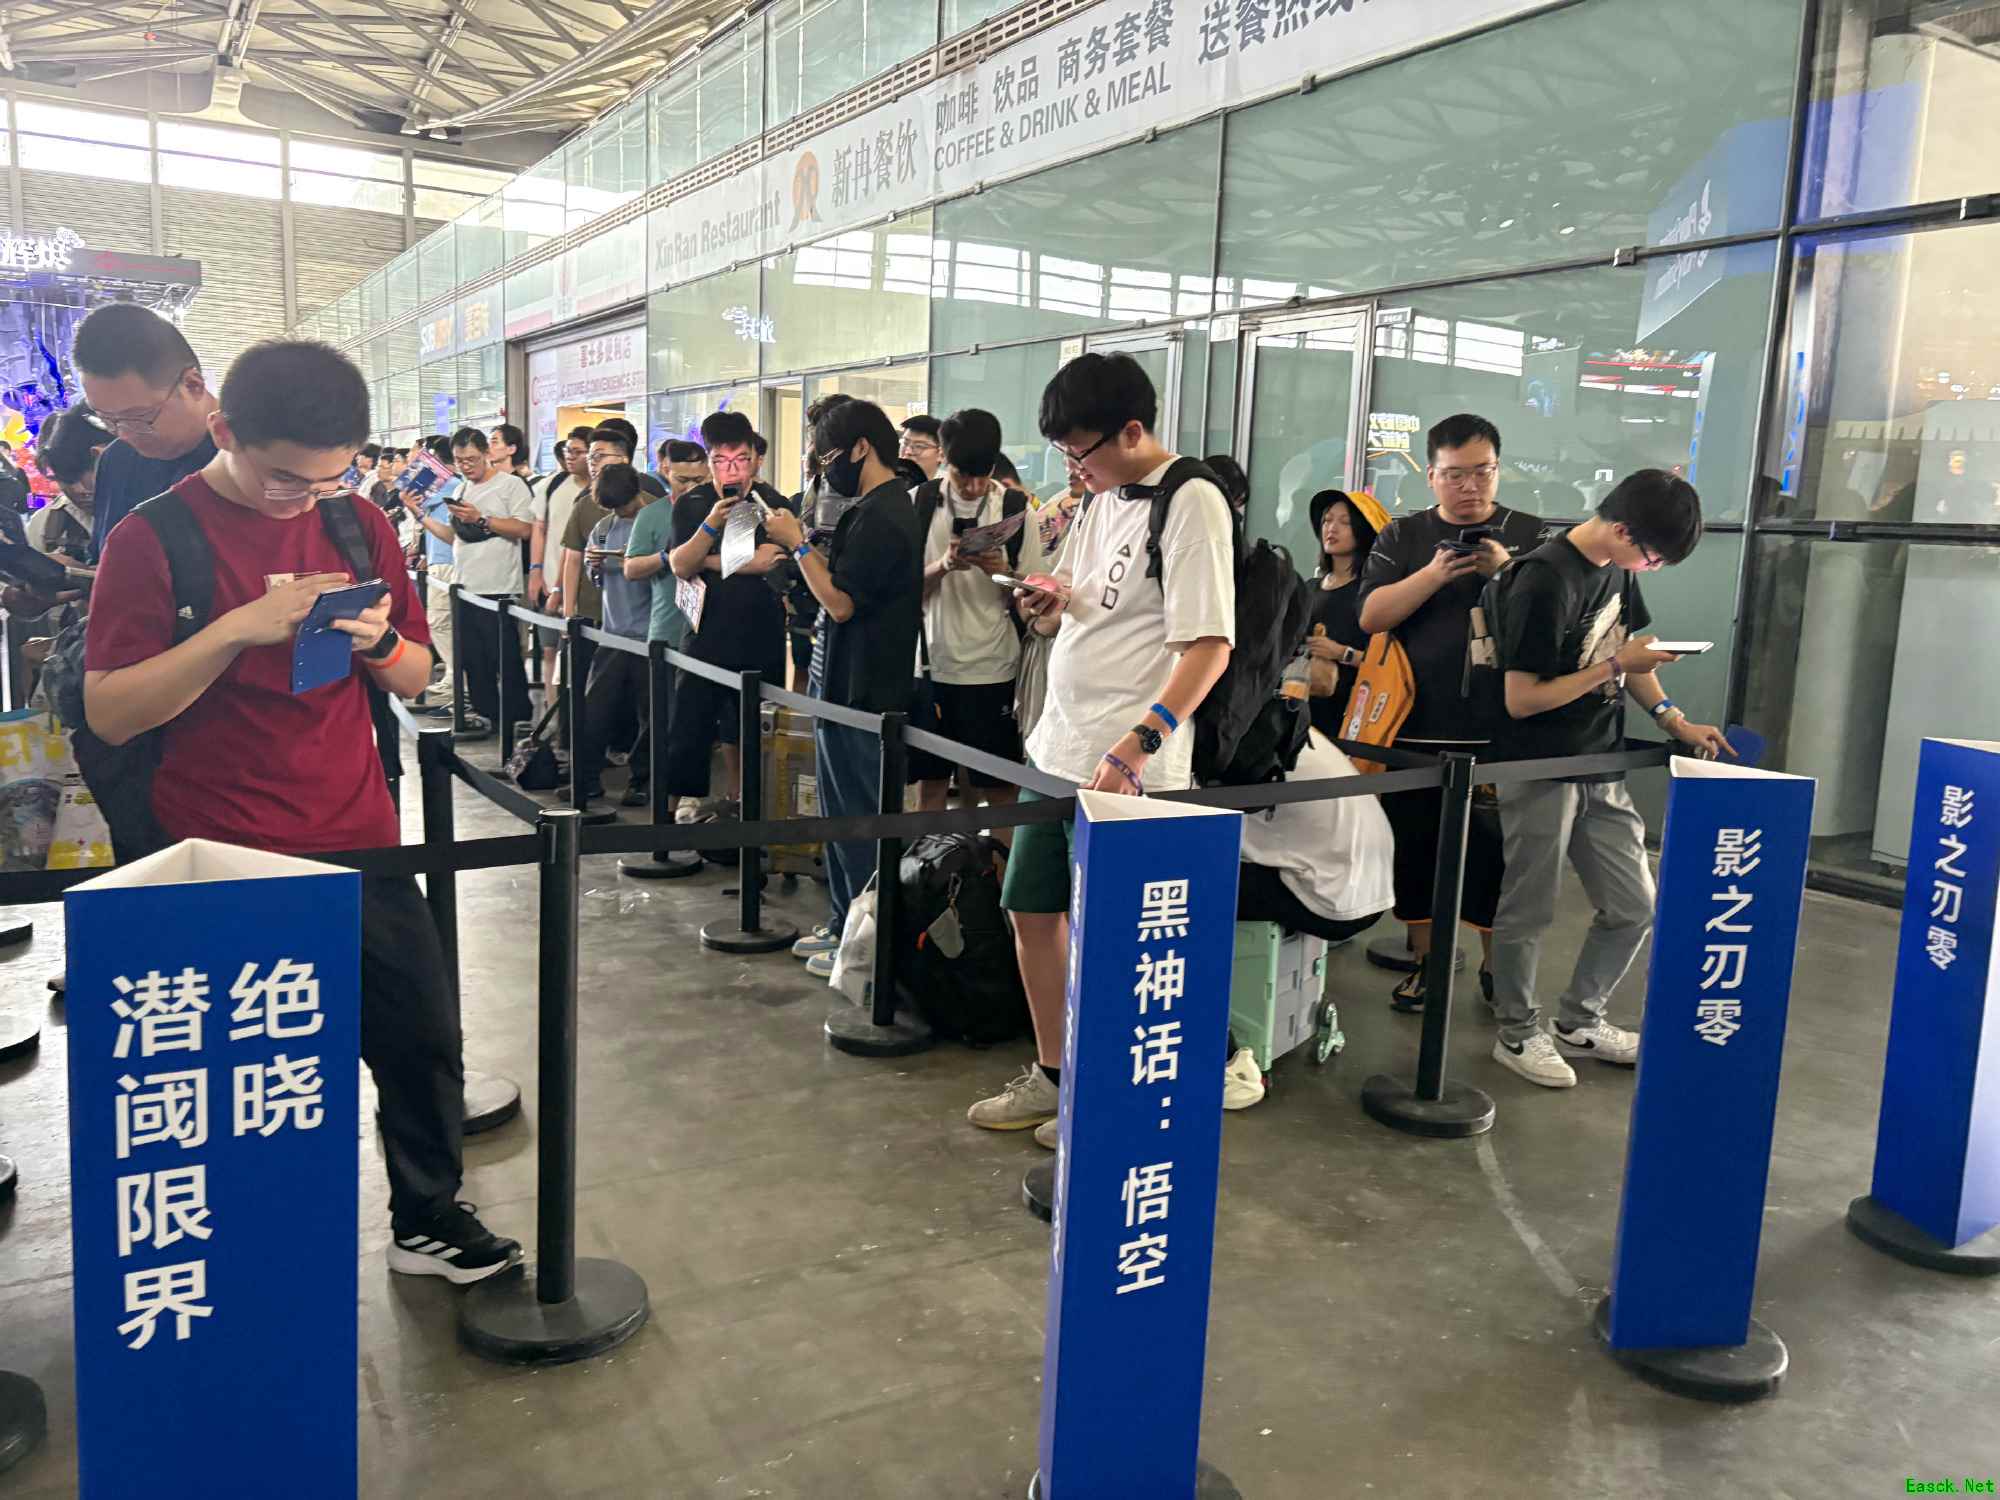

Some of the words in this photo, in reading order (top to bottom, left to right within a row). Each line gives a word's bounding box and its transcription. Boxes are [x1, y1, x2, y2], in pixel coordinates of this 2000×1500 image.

[934, 125, 995, 172] COFFEE
[1000, 120, 1013, 149] &
[1019, 94, 1079, 143] DRINK
[1084, 87, 1100, 119] &
[1107, 60, 1172, 112] MEAL
[936, 80, 978, 136] 咖啡
[993, 55, 1039, 114] 饮品
[1056, 0, 1174, 90] 商务套餐
[702, 189, 781, 254] Restaurant
[832, 118, 918, 208] 新冉餐饮
[1693, 828, 1762, 1047] 影之刃零
[1925, 785, 1975, 972] 影之刃零
[229, 957, 325, 1138] 绝晓
[109, 966, 214, 1351] 潜阈限界
